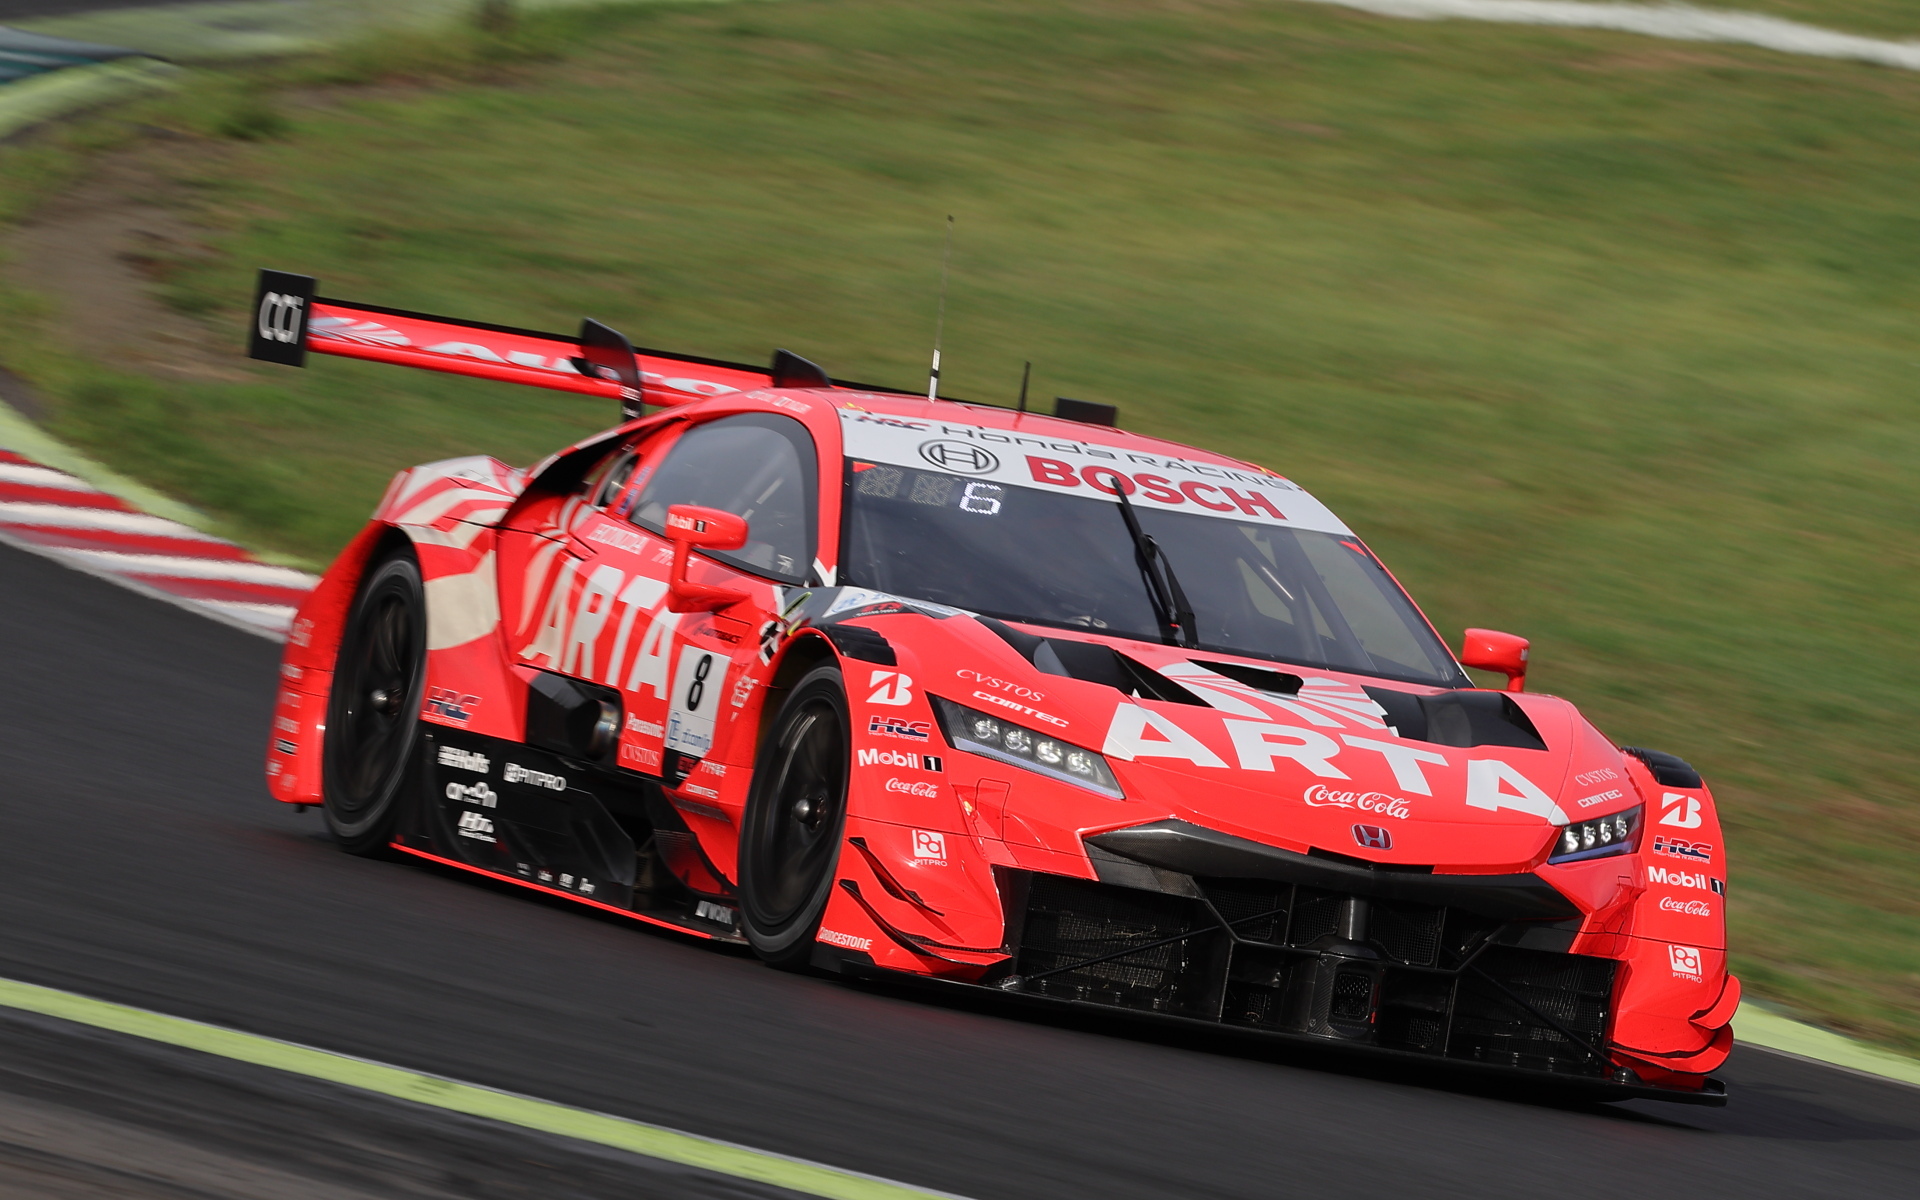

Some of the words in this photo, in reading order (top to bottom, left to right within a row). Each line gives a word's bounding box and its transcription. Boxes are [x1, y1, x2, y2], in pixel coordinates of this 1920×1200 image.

[941, 426, 1117, 459] Honda
[1127, 453, 1295, 492] RACING
[958, 481, 1002, 515] 6
[1025, 455, 1288, 520] BOSCH
[517, 557, 683, 701] ARTA
[687, 654, 712, 711] 8
[956, 669, 1045, 702] CVSTOS
[972, 690, 1070, 727] COMTEC
[868, 715, 931, 738] HRC
[857, 748, 919, 769] Mobil
[1101, 702, 1572, 827] ARTA
[885, 778, 938, 798] Coca-Cola
[1575, 768, 1618, 787] CVSTOS
[1303, 784, 1411, 819] Coca-Cola
[1577, 789, 1623, 808] COMTEC
[1653, 835, 1712, 860] HRC
[914, 859, 948, 867] PITPRO
[1647, 866, 1707, 890] Mobil
[1659, 897, 1711, 917] Coca-Cola
[818, 926, 873, 950] BRIDGESTONE
[1672, 972, 1703, 984] PITPRO
